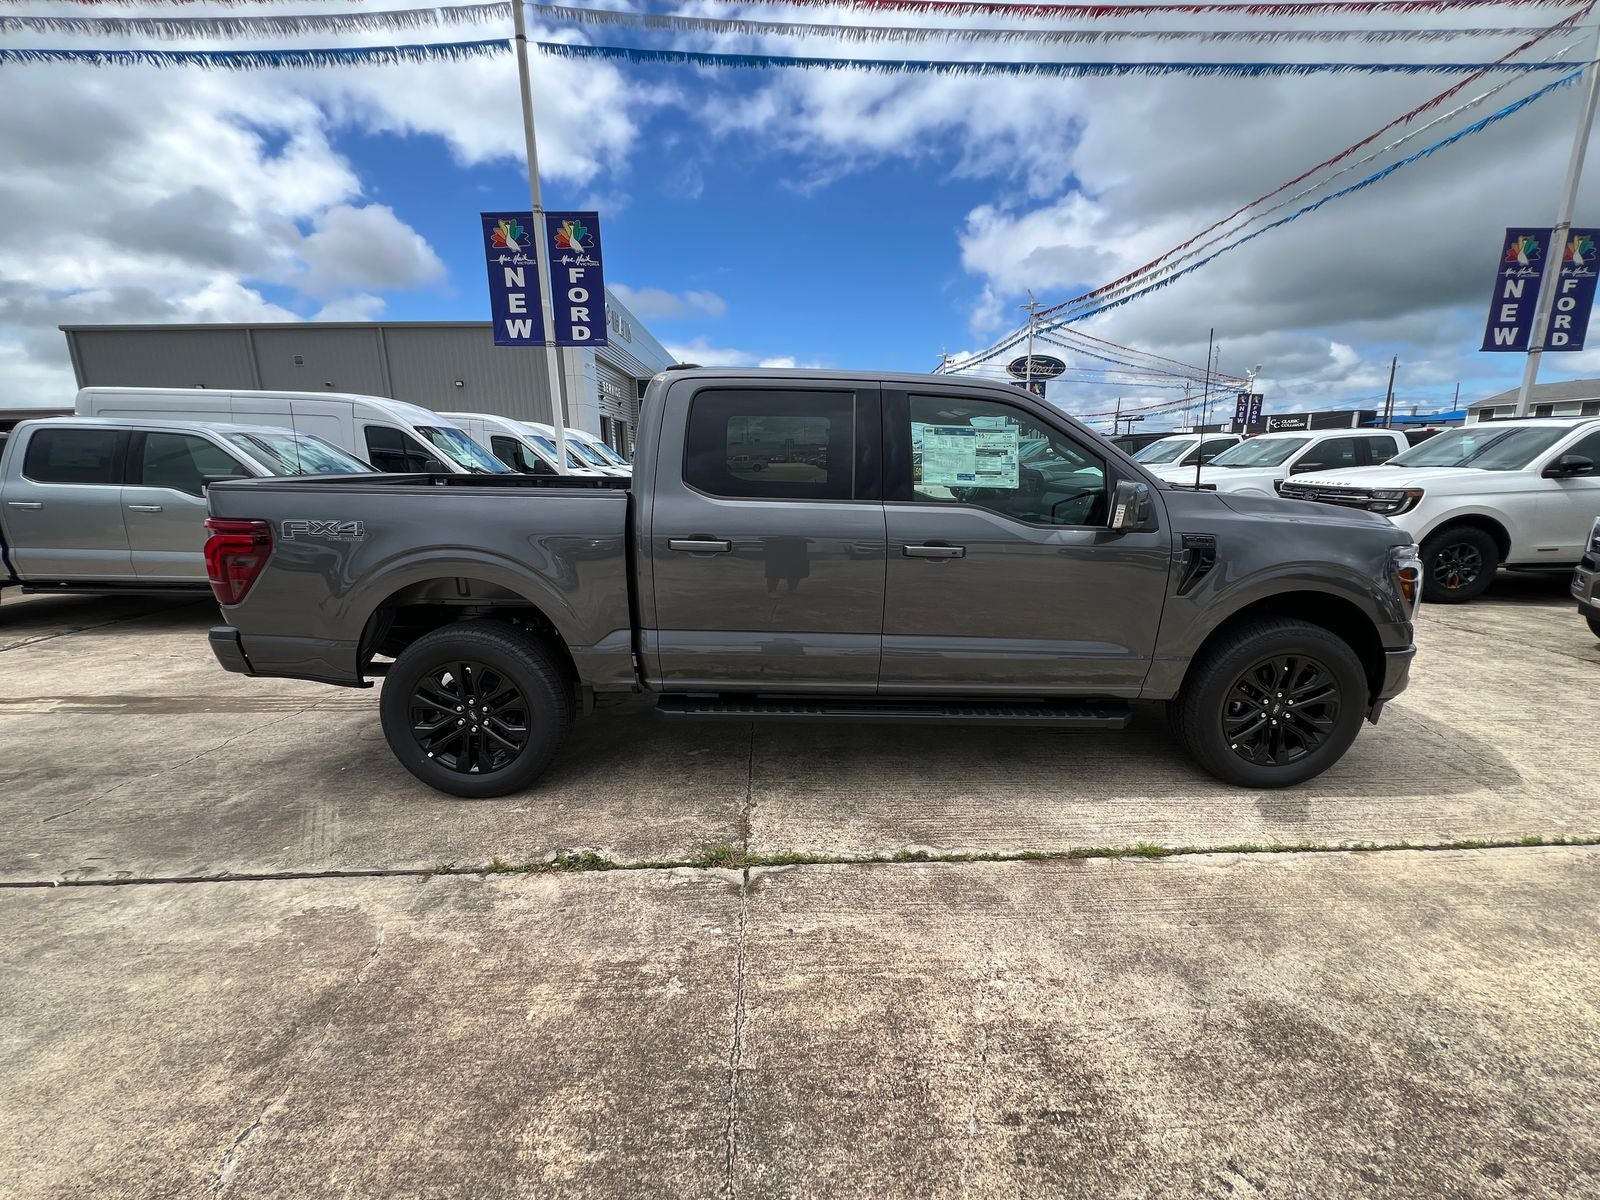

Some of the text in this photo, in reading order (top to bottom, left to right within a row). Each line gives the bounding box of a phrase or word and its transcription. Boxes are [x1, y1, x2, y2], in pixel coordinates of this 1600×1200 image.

[504, 267, 532, 339] NEW
[568, 268, 591, 341] FORD
[1494, 279, 1525, 345] NEW
[1551, 279, 1579, 346] FORD
[1237, 406, 1245, 424] NEW
[281, 519, 364, 540] FX4
